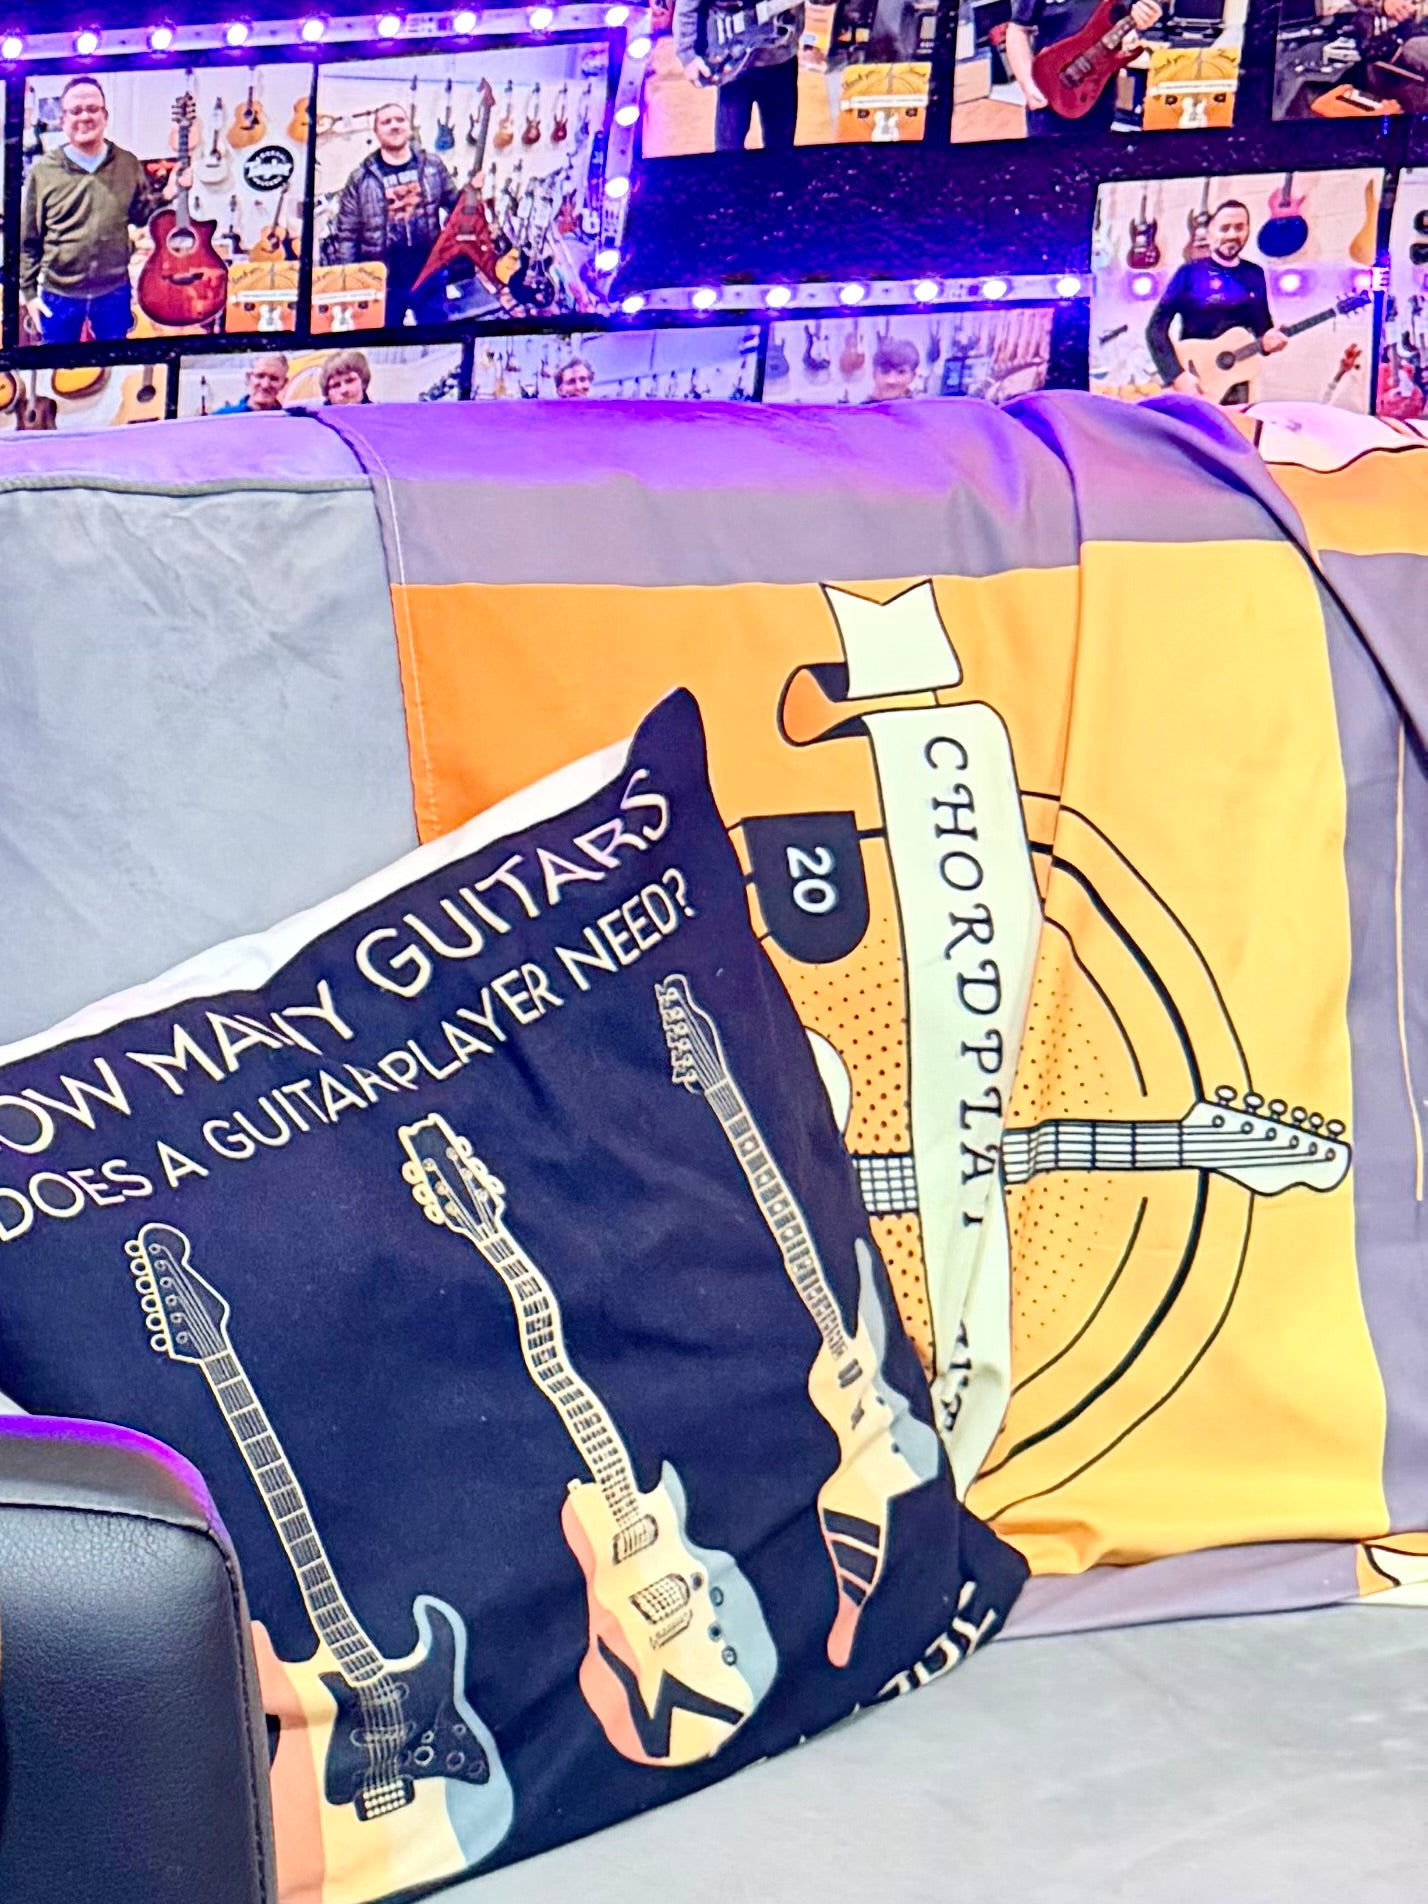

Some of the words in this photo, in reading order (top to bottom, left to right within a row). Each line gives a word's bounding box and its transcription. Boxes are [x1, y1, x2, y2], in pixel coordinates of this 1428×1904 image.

[138, 979, 362, 1103] MANY
[355, 768, 675, 1002] GUITARS
[164, 1135, 210, 1192] A
[552, 864, 695, 997] NEED?
[785, 843, 836, 915] 20
[924, 735, 1004, 1229] CHORDPLA
